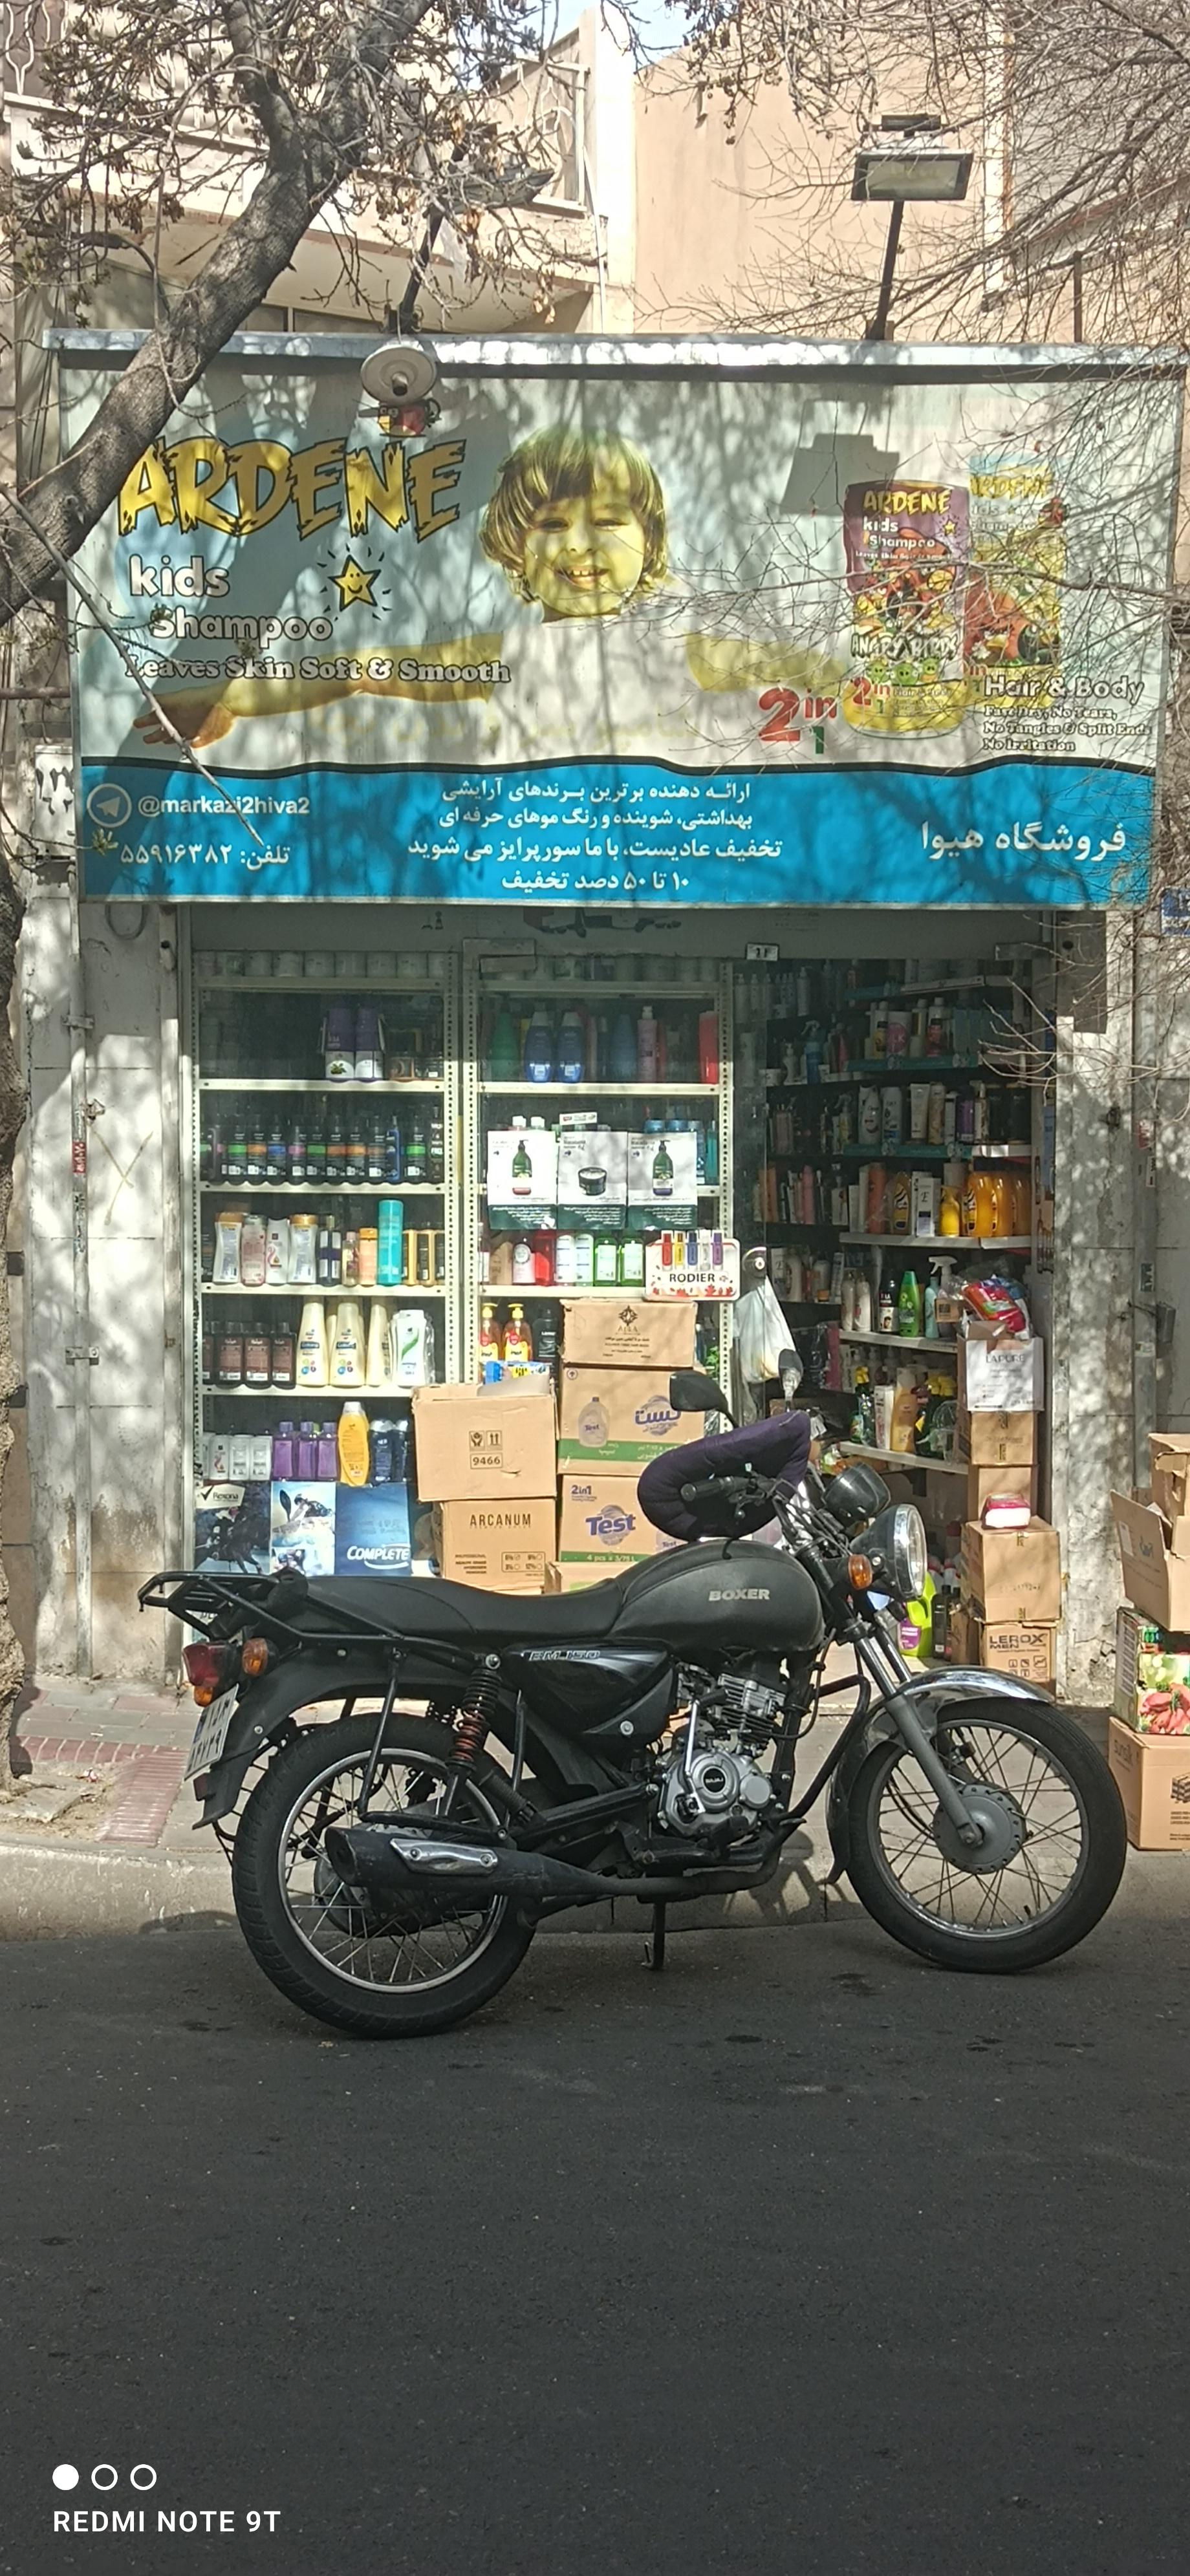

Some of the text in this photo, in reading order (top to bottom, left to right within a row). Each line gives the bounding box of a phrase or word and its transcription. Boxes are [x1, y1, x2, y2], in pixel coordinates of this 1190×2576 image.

[117, 435, 466, 542] ARDENE
[862, 489, 952, 516] ARDENE
[863, 516, 899, 533] kids
[870, 535, 936, 551] Shampoo
[129, 554, 230, 598] kids
[149, 606, 334, 648] Shampoo
[126, 654, 511, 683] Leaves Skin Soft & Smooth
[852, 677, 872, 706] 2
[984, 674, 1144, 705] Hair & Body
[758, 686, 837, 755] 2 in 1
[1051, 707, 1072, 718] No
[1074, 707, 1118, 721] Tears,
[983, 722, 1004, 733] No
[1007, 722, 1061, 736] Tangles
[1077, 723, 1114, 737] Split
[1116, 724, 1152, 736] Ends
[982, 738, 1076, 751] No Irritation
[442, 775, 503, 802] آرایشی
[589, 784, 644, 804] برترین
[649, 785, 700, 799] دهنده
[138, 795, 310, 817] @markazi2hiva2
[439, 807, 752, 832] بهداشتی، شوینده و رنگ موهای حرفه ای
[407, 837, 783, 863] تخفیف عادیست، با ما سورپرایز می شوید
[922, 821, 1126, 861] فروشگاه هیوا
[120, 844, 290, 871] تلفن: ۵۵۹۱۶۳۸۲
[502, 871, 569, 893] تخفیف
[623, 872, 645, 890] ۵۰
[652, 872, 666, 890] تا
[672, 872, 689, 890] ۱۰
[669, 1272, 715, 1283] RODIER
[473, 1456, 501, 1466] 9466
[470, 1514, 531, 1527] ARCANUM
[585, 1514, 636, 1536] Test
[347, 1545, 411, 1562] COMPLETE
[708, 1588, 770, 1602] BOXER
[990, 1633, 1048, 1646] LEROX
[565, 1650, 600, 1660] 150
